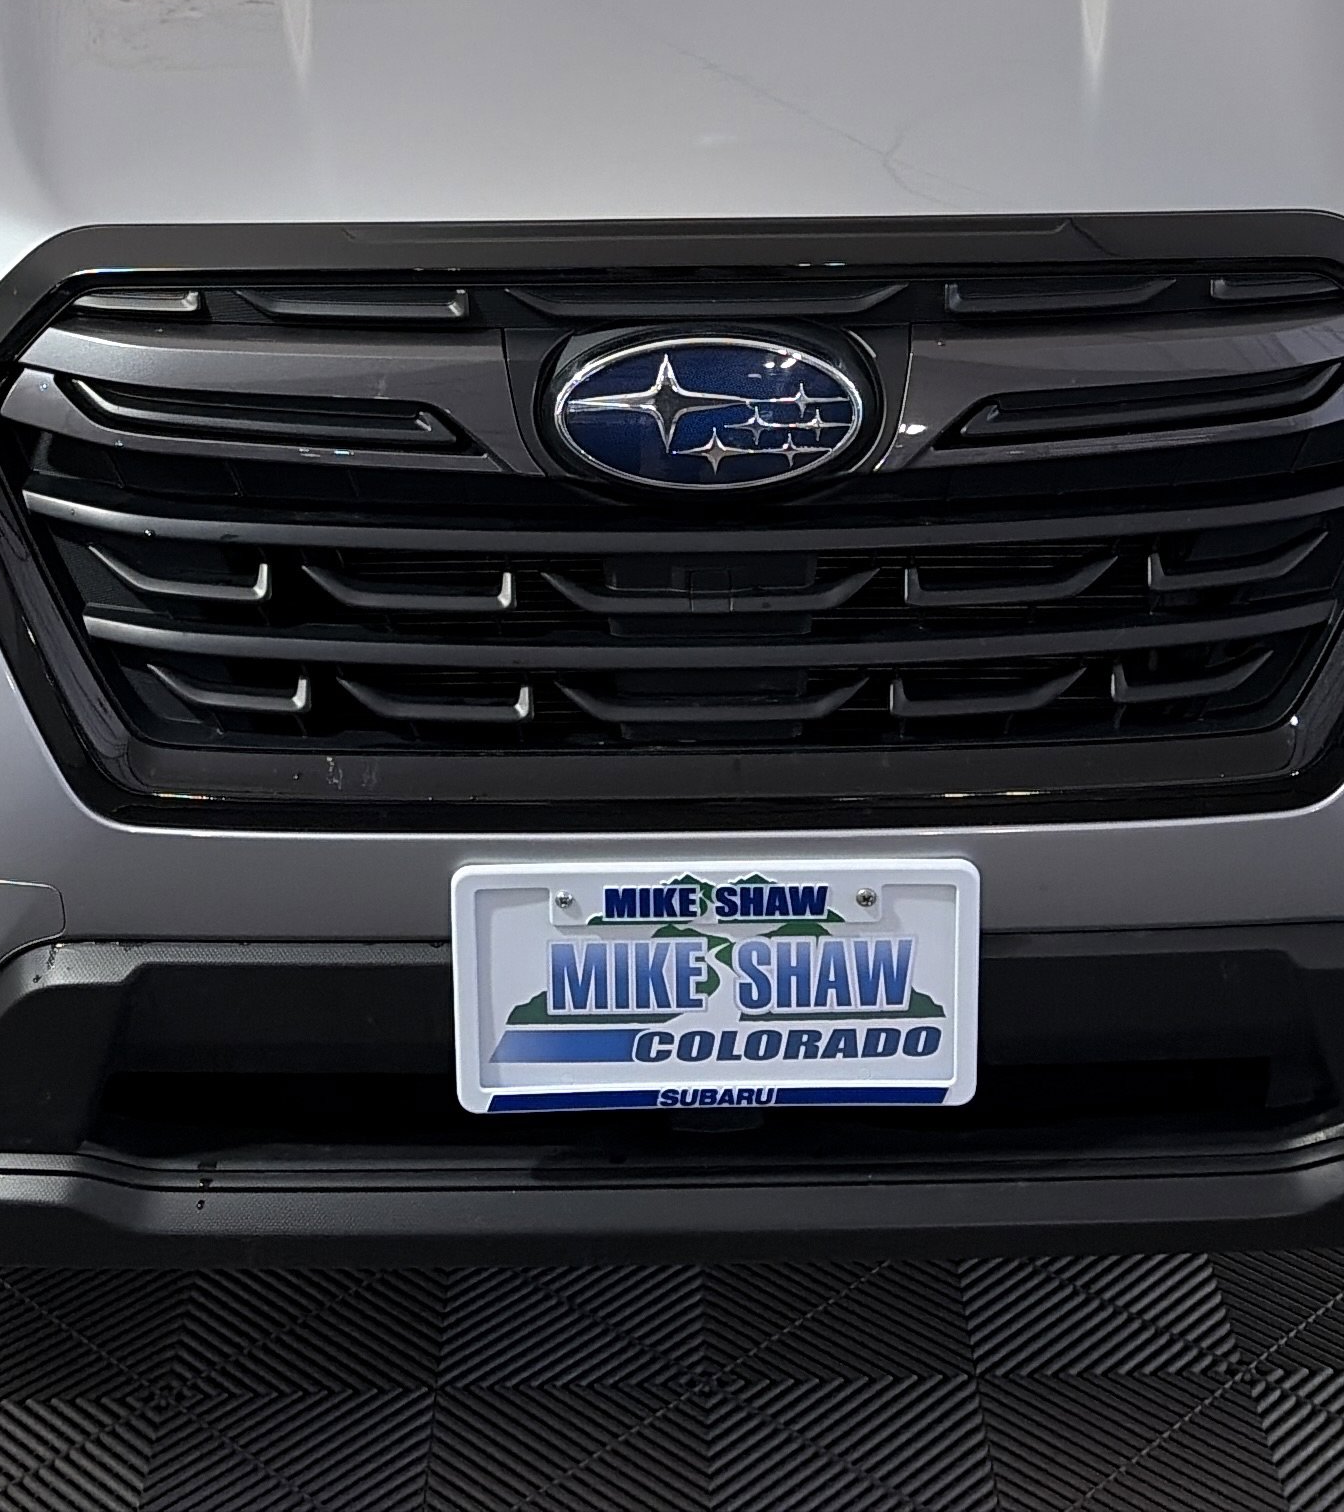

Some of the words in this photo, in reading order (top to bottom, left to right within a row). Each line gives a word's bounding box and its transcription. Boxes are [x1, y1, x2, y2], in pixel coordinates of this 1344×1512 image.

[604, 888, 698, 918] MIKE
[716, 886, 828, 917] SHAW
[552, 943, 705, 1010] MIKE
[738, 941, 913, 1010] SHAW
[635, 1026, 942, 1062] COLORADO
[660, 1088, 774, 1106] SUBARU
